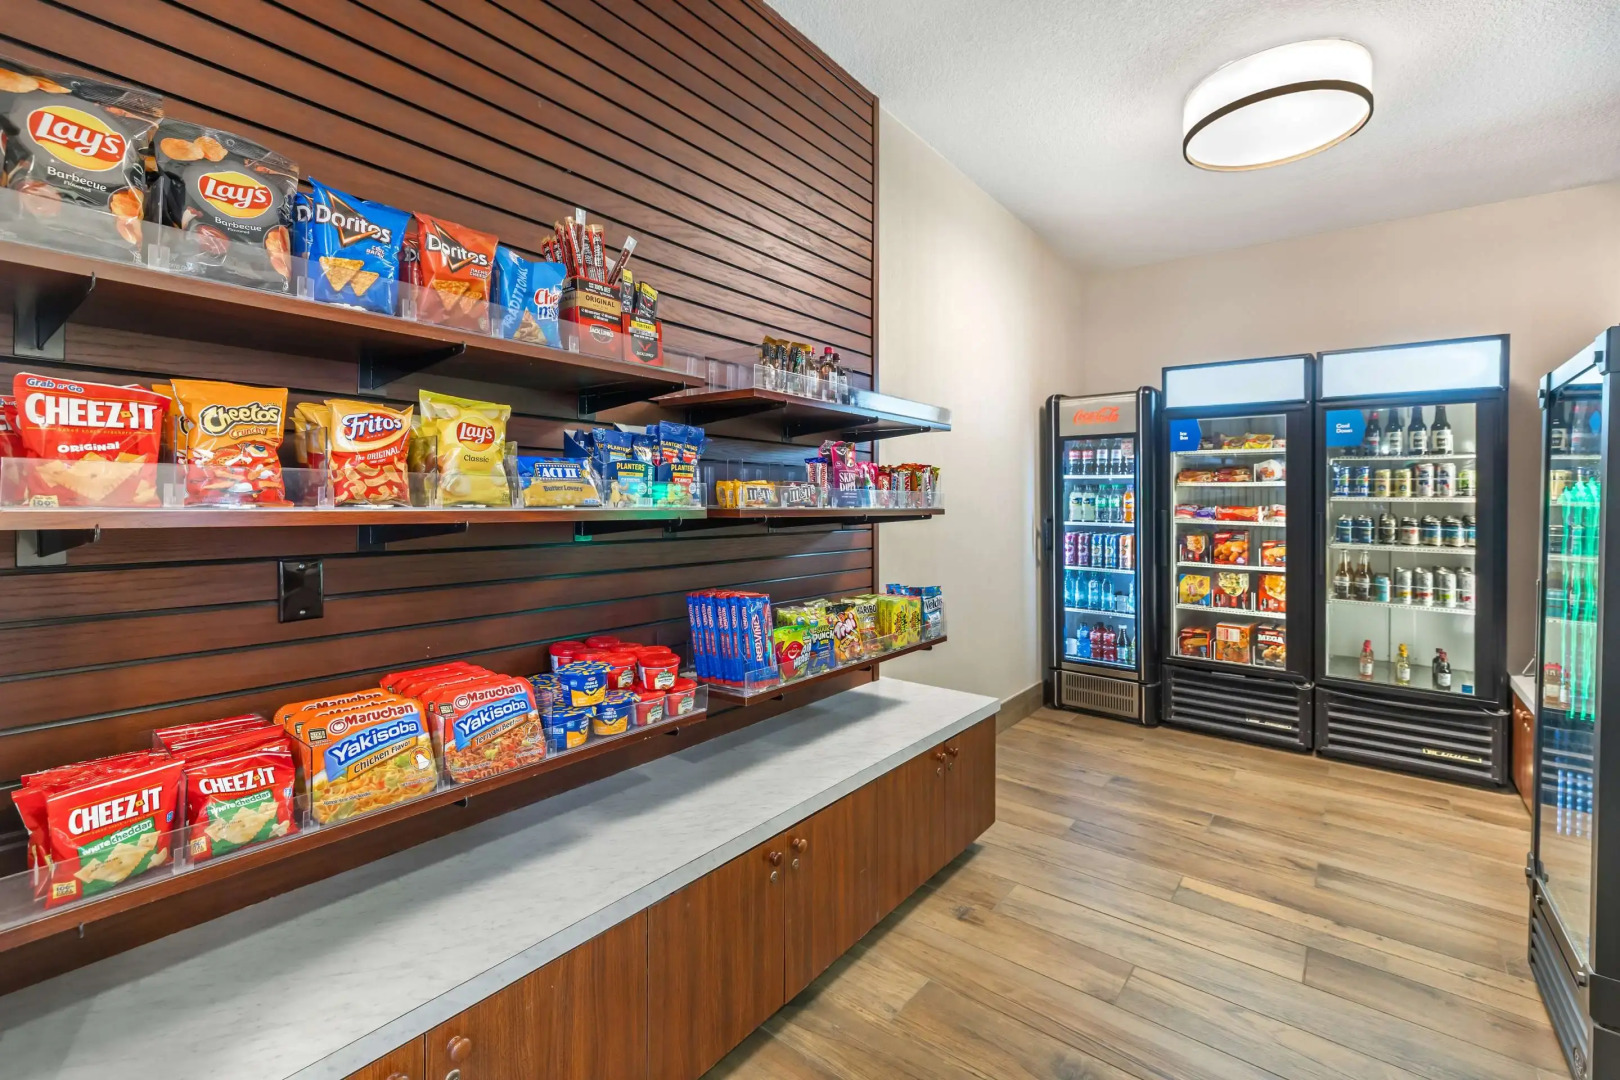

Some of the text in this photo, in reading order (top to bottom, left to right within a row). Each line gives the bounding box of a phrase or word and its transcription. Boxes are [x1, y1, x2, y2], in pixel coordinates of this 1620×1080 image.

[35, 113, 122, 156] Lay's
[47, 165, 108, 192] Barbecue
[204, 178, 268, 208] Lay's
[215, 216, 262, 232] Barbecue
[315, 204, 391, 243] Doritos
[427, 232, 488, 265] Doritos
[502, 265, 528, 329] TRADITIONAL
[585, 295, 615, 308] ORIGINAL
[26, 378, 55, 389] Grab
[67, 385, 84, 393] Go
[25, 393, 157, 430] CHEEZ-IT
[200, 404, 281, 434] Cheetos
[229, 426, 268, 440] Crunchy
[342, 412, 402, 441] Fritos
[459, 422, 494, 444] Lay's
[367, 446, 400, 460] ORIGINAL
[463, 454, 490, 463] Classic
[616, 462, 645, 471] PLANTERS
[542, 467, 563, 478] ACT
[671, 464, 695, 472] PLANTERS
[467, 684, 522, 702] Maruchan
[344, 704, 414, 727] Maruchan
[458, 699, 527, 736] Yakisoba
[331, 721, 418, 763] Yakisoba
[475, 725, 502, 746] Teriyaki
[502, 719, 515, 731] Beef
[353, 740, 411, 774] Chicken Flavor
[198, 767, 276, 795] CHEEZ-IT
[68, 786, 163, 835] CHEEZ-IT
[236, 791, 271, 807] cheddar
[111, 820, 152, 845] cheddar
